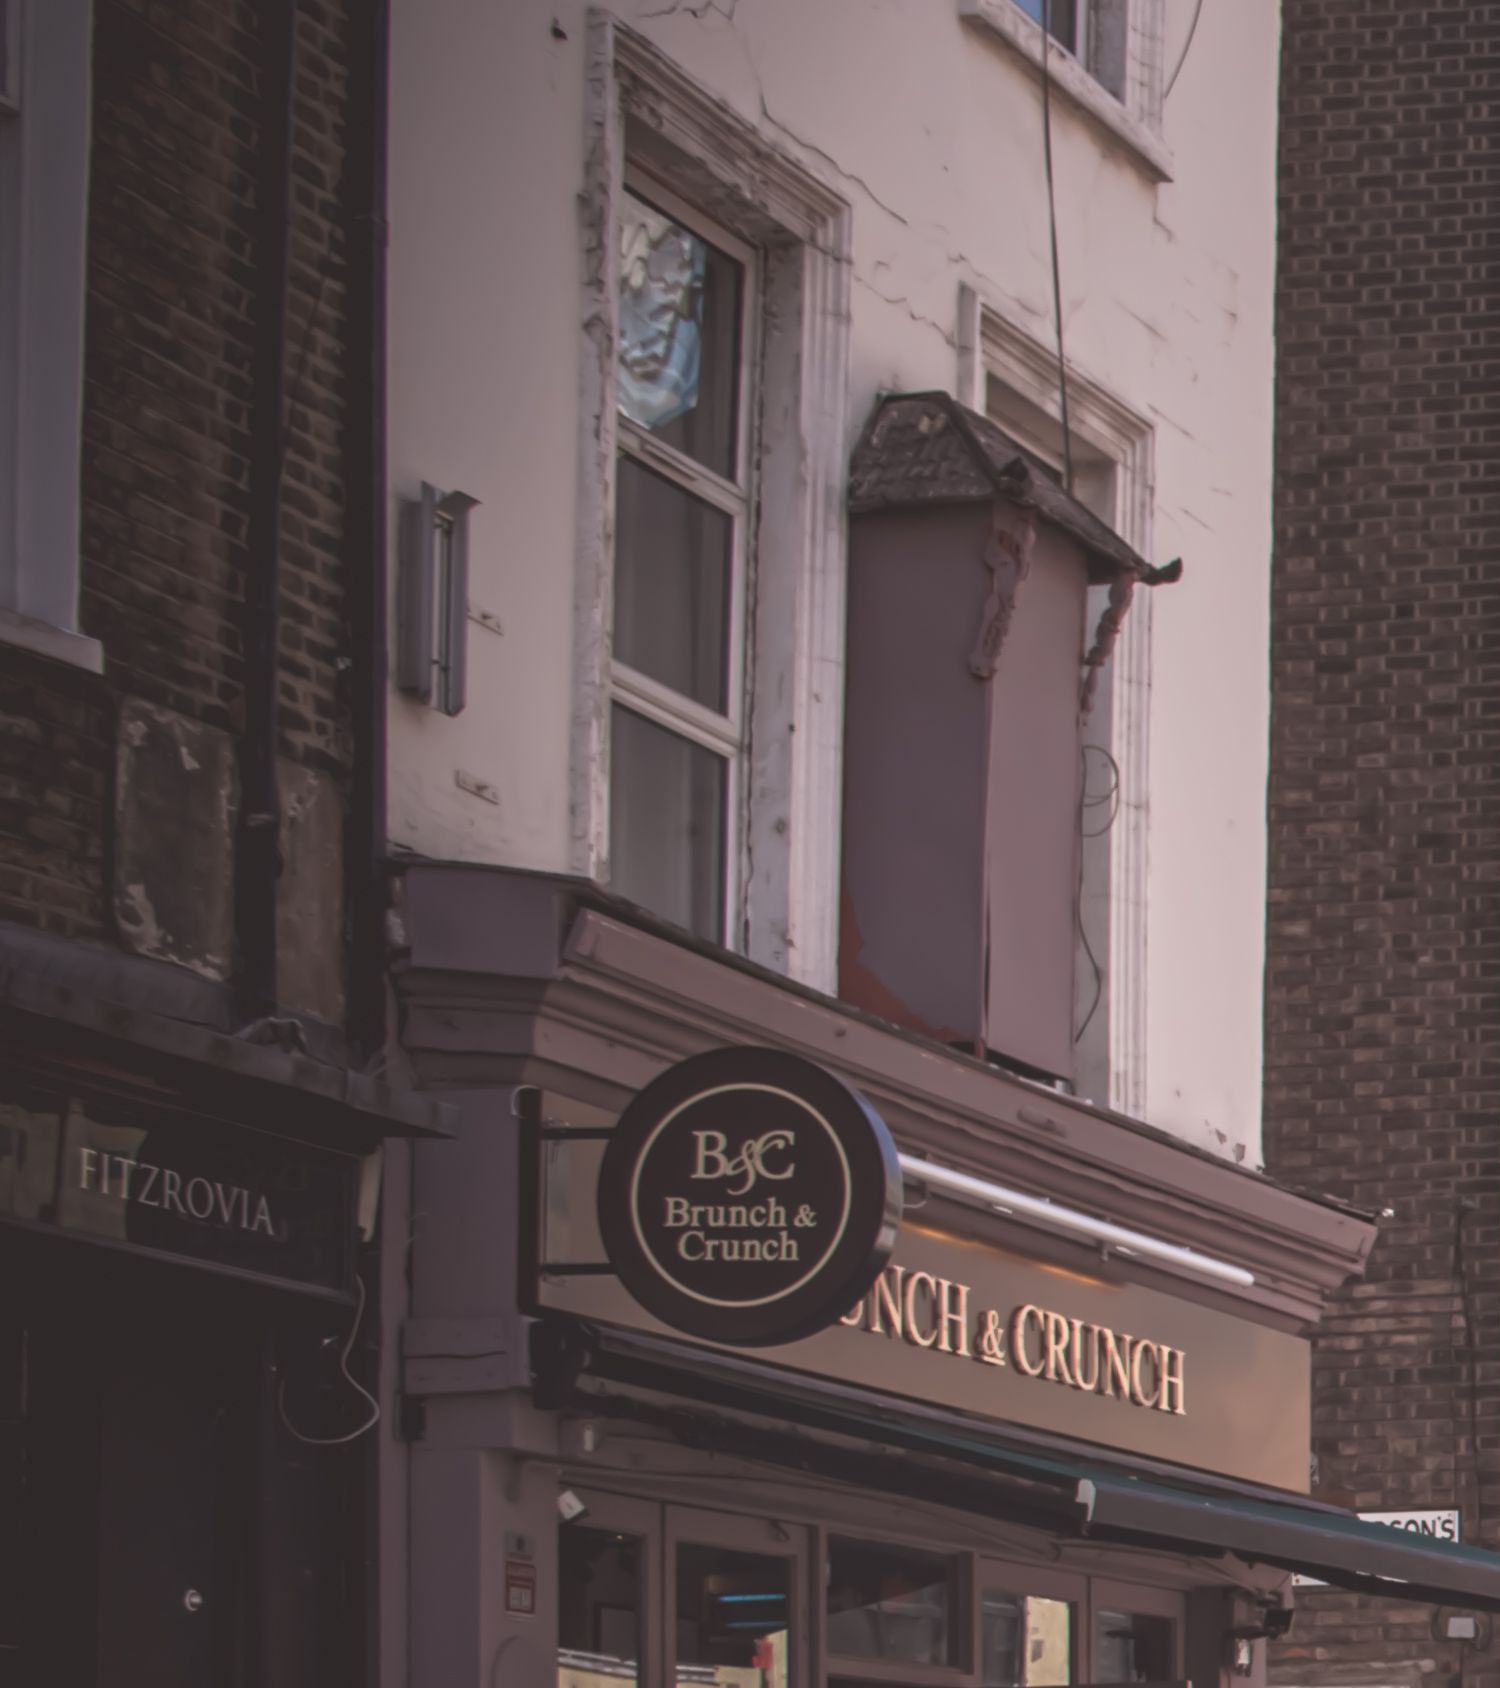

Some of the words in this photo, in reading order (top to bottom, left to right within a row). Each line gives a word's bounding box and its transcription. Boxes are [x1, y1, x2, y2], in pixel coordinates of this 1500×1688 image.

[79, 1147, 275, 1236] FITZROVIA
[664, 1196, 787, 1227] Brunch
[793, 1204, 817, 1227] &
[678, 1230, 799, 1261] Crunch
[840, 1265, 971, 1357] NCH
[978, 1309, 1006, 1366] &
[1012, 1304, 1187, 1416] CRUNCH
